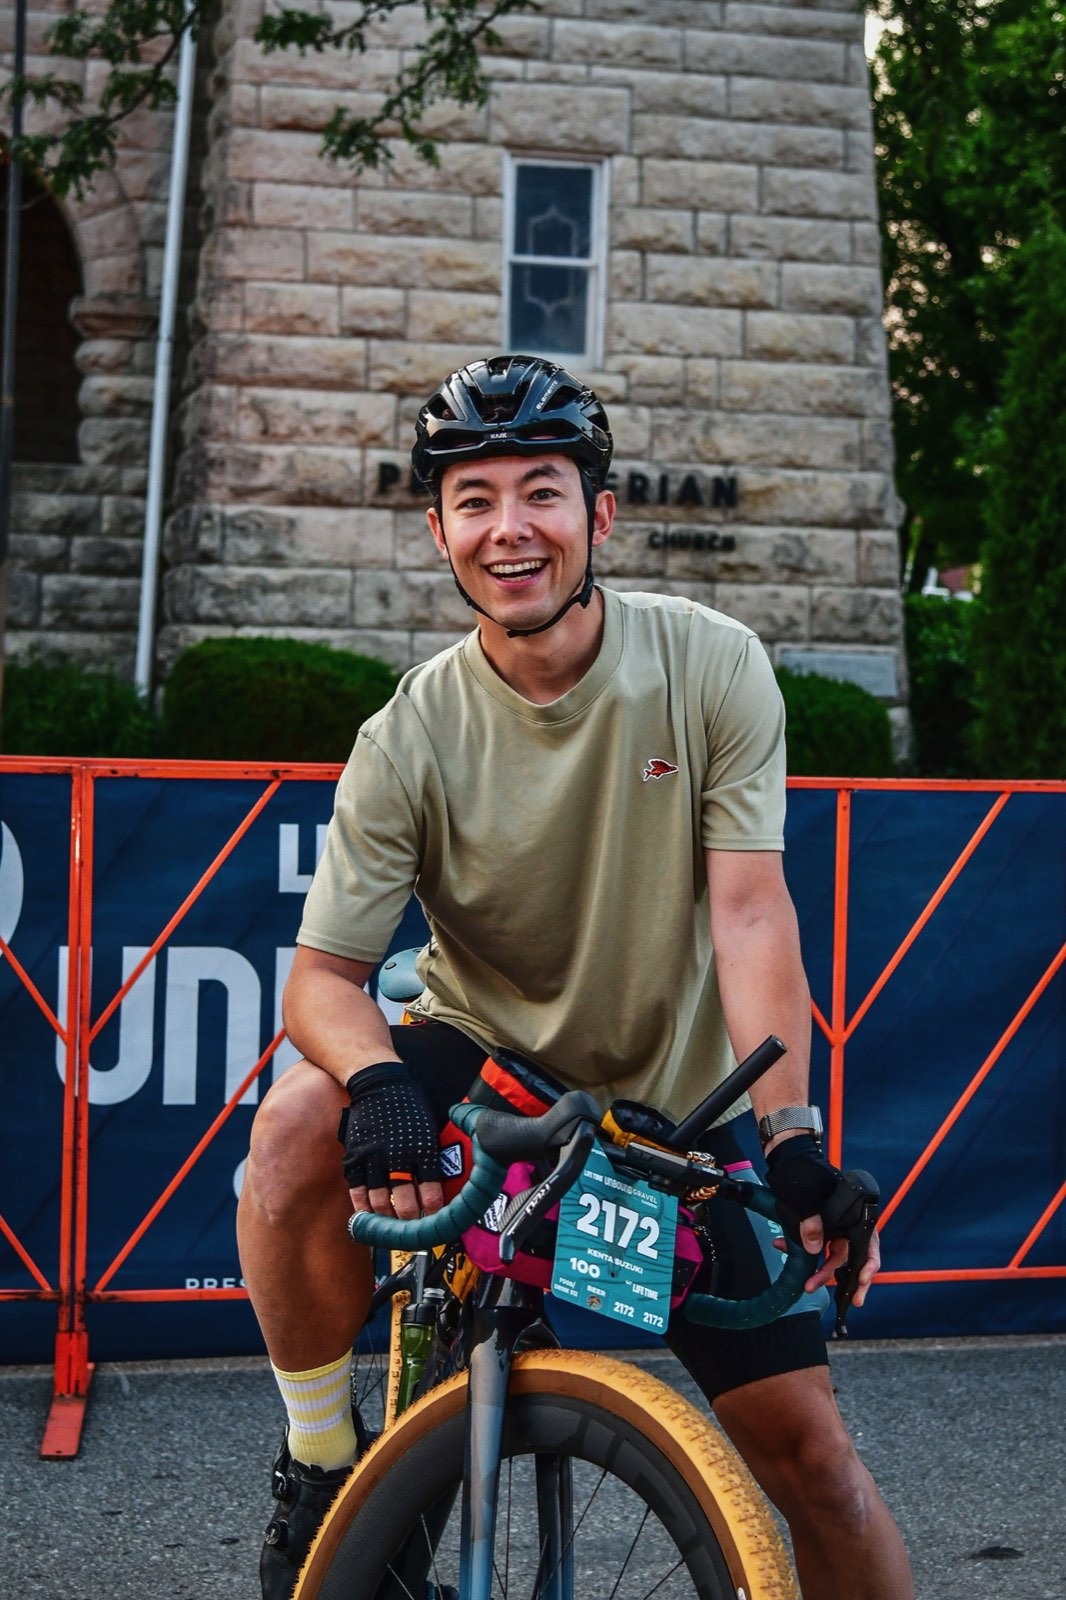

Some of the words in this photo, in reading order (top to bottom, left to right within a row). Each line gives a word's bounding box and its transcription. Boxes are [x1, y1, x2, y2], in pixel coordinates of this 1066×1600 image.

[633, 1190, 658, 1204] GRAVEL
[577, 1193, 659, 1259] 2172
[569, 1256, 601, 1279] 100
[587, 1248, 613, 1263] KENTA
[614, 1258, 643, 1274] SUZUKI
[613, 1302, 635, 1318] 2172
[643, 1312, 664, 1328] 2172
